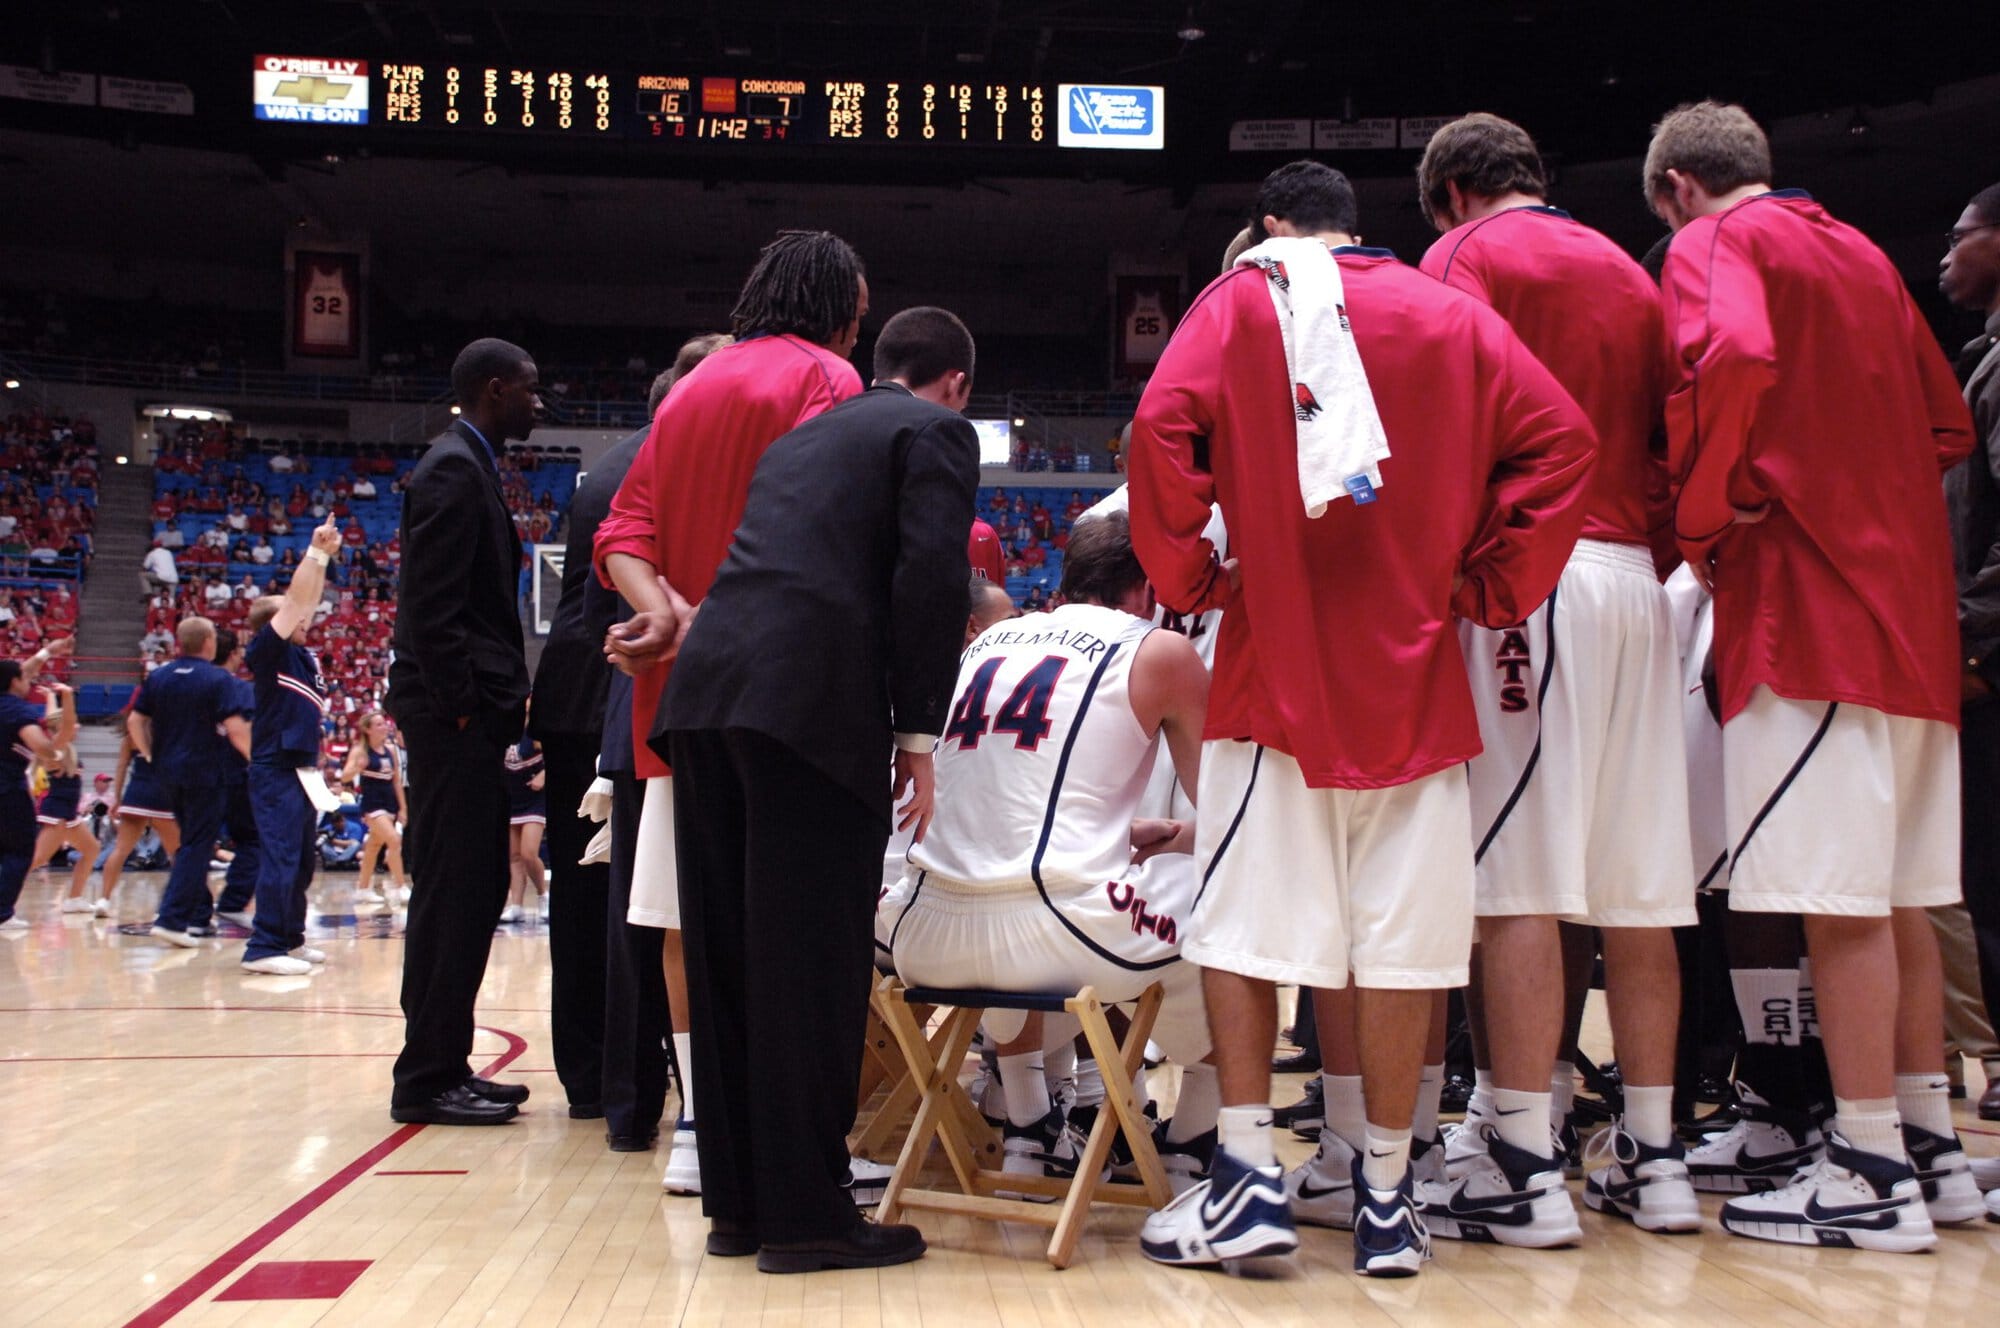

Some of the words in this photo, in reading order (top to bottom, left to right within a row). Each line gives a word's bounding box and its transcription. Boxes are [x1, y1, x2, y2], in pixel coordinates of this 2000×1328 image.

[264, 57, 359, 75] O'RIELLY
[383, 64, 424, 80] PLYR
[447, 67, 459, 81] 0
[484, 69, 497, 83] 5
[510, 70, 535, 85] 34
[548, 72, 572, 87] 43
[585, 74, 609, 89] 44
[638, 76, 690, 91] ARIZONA
[390, 79, 420, 94] PTS
[447, 81, 459, 95] 0
[597, 88, 609, 103] 0
[741, 80, 806, 95] CONCORDIA
[825, 82, 865, 97] PLYR
[887, 83, 899, 97] 7
[950, 84, 971, 99] 10
[1022, 86, 1043, 101] 14
[264, 104, 360, 122] WATSON
[387, 92, 421, 107] RBS
[597, 102, 609, 117] 0
[661, 93, 680, 114] 16
[778, 97, 790, 117] 7
[832, 96, 861, 110] PTS
[995, 100, 1007, 114] 0
[1031, 100, 1043, 115] 0
[447, 109, 459, 124] 0
[484, 110, 497, 125] 0
[522, 112, 535, 127] 0
[560, 115, 572, 129] 0
[597, 116, 609, 131] 0
[830, 109, 862, 124] RBS
[887, 110, 899, 125] 0
[1031, 114, 1043, 128] 0
[830, 123, 862, 138] FLS
[887, 124, 899, 139] 0
[923, 124, 935, 139] 0
[1031, 127, 1043, 142] 0
[312, 295, 342, 315] 32
[1135, 317, 1160, 336] 25
[944, 655, 1069, 752] 44
